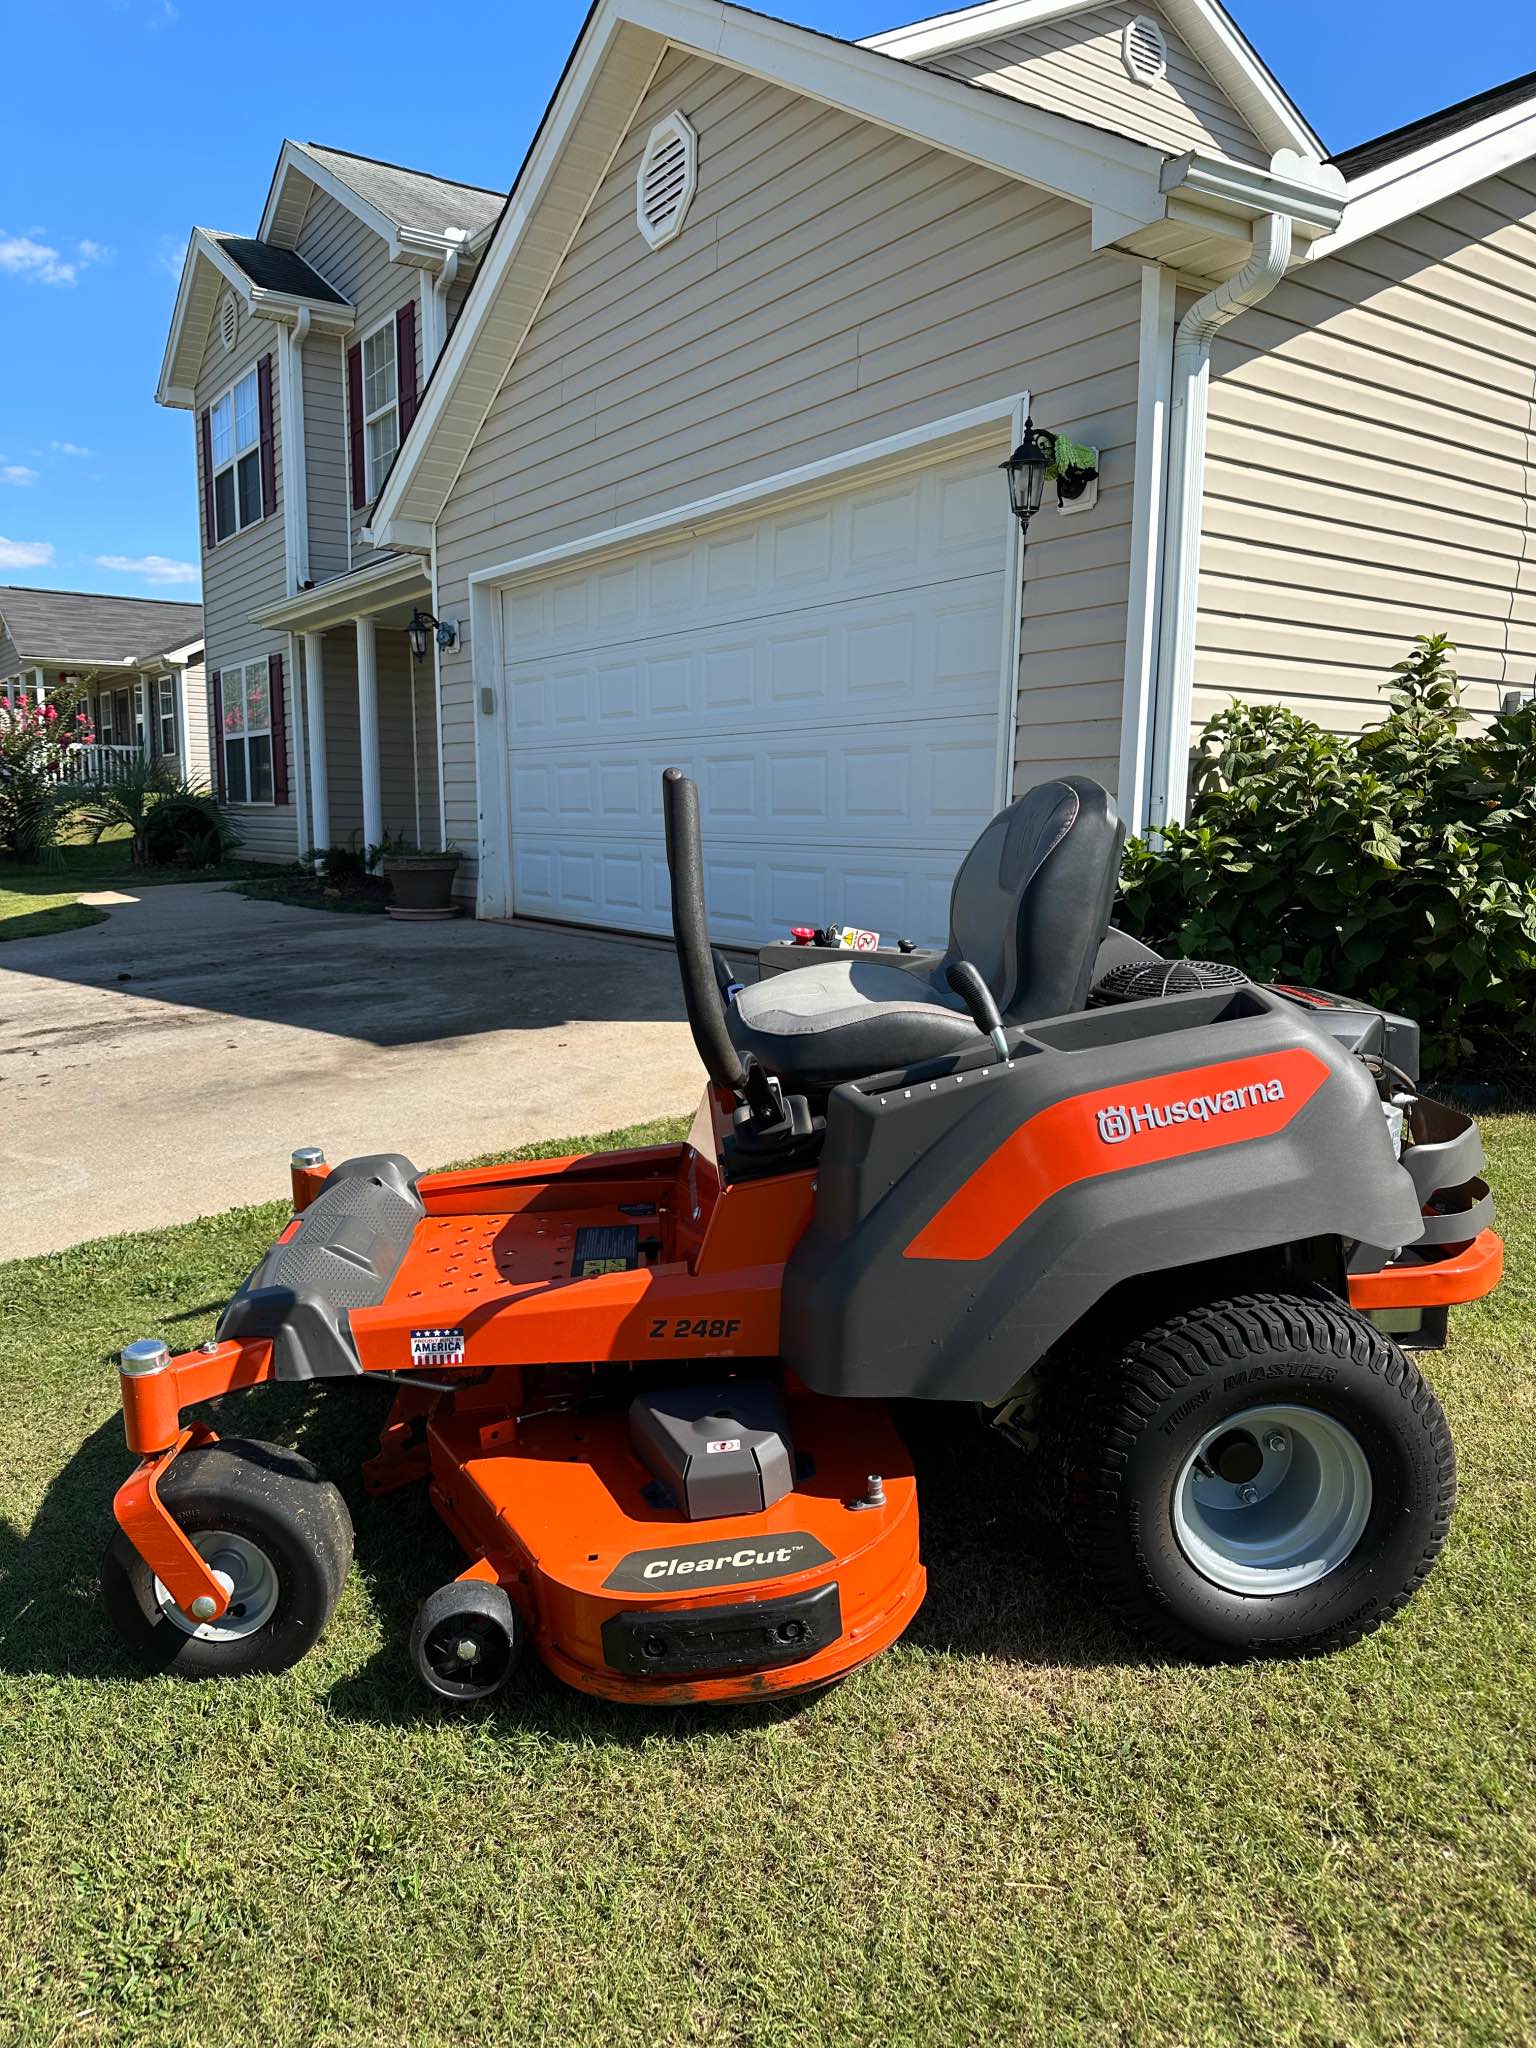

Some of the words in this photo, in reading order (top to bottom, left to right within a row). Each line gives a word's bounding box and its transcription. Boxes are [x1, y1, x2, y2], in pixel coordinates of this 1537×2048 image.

[1130, 1079, 1285, 1133] Husqvarna
[649, 1319, 667, 1338] Z
[673, 1319, 741, 1338] 248F
[414, 1342, 461, 1352] AMERICA
[1159, 1383, 1215, 1436] TURF
[1223, 1362, 1339, 1393] MASTER
